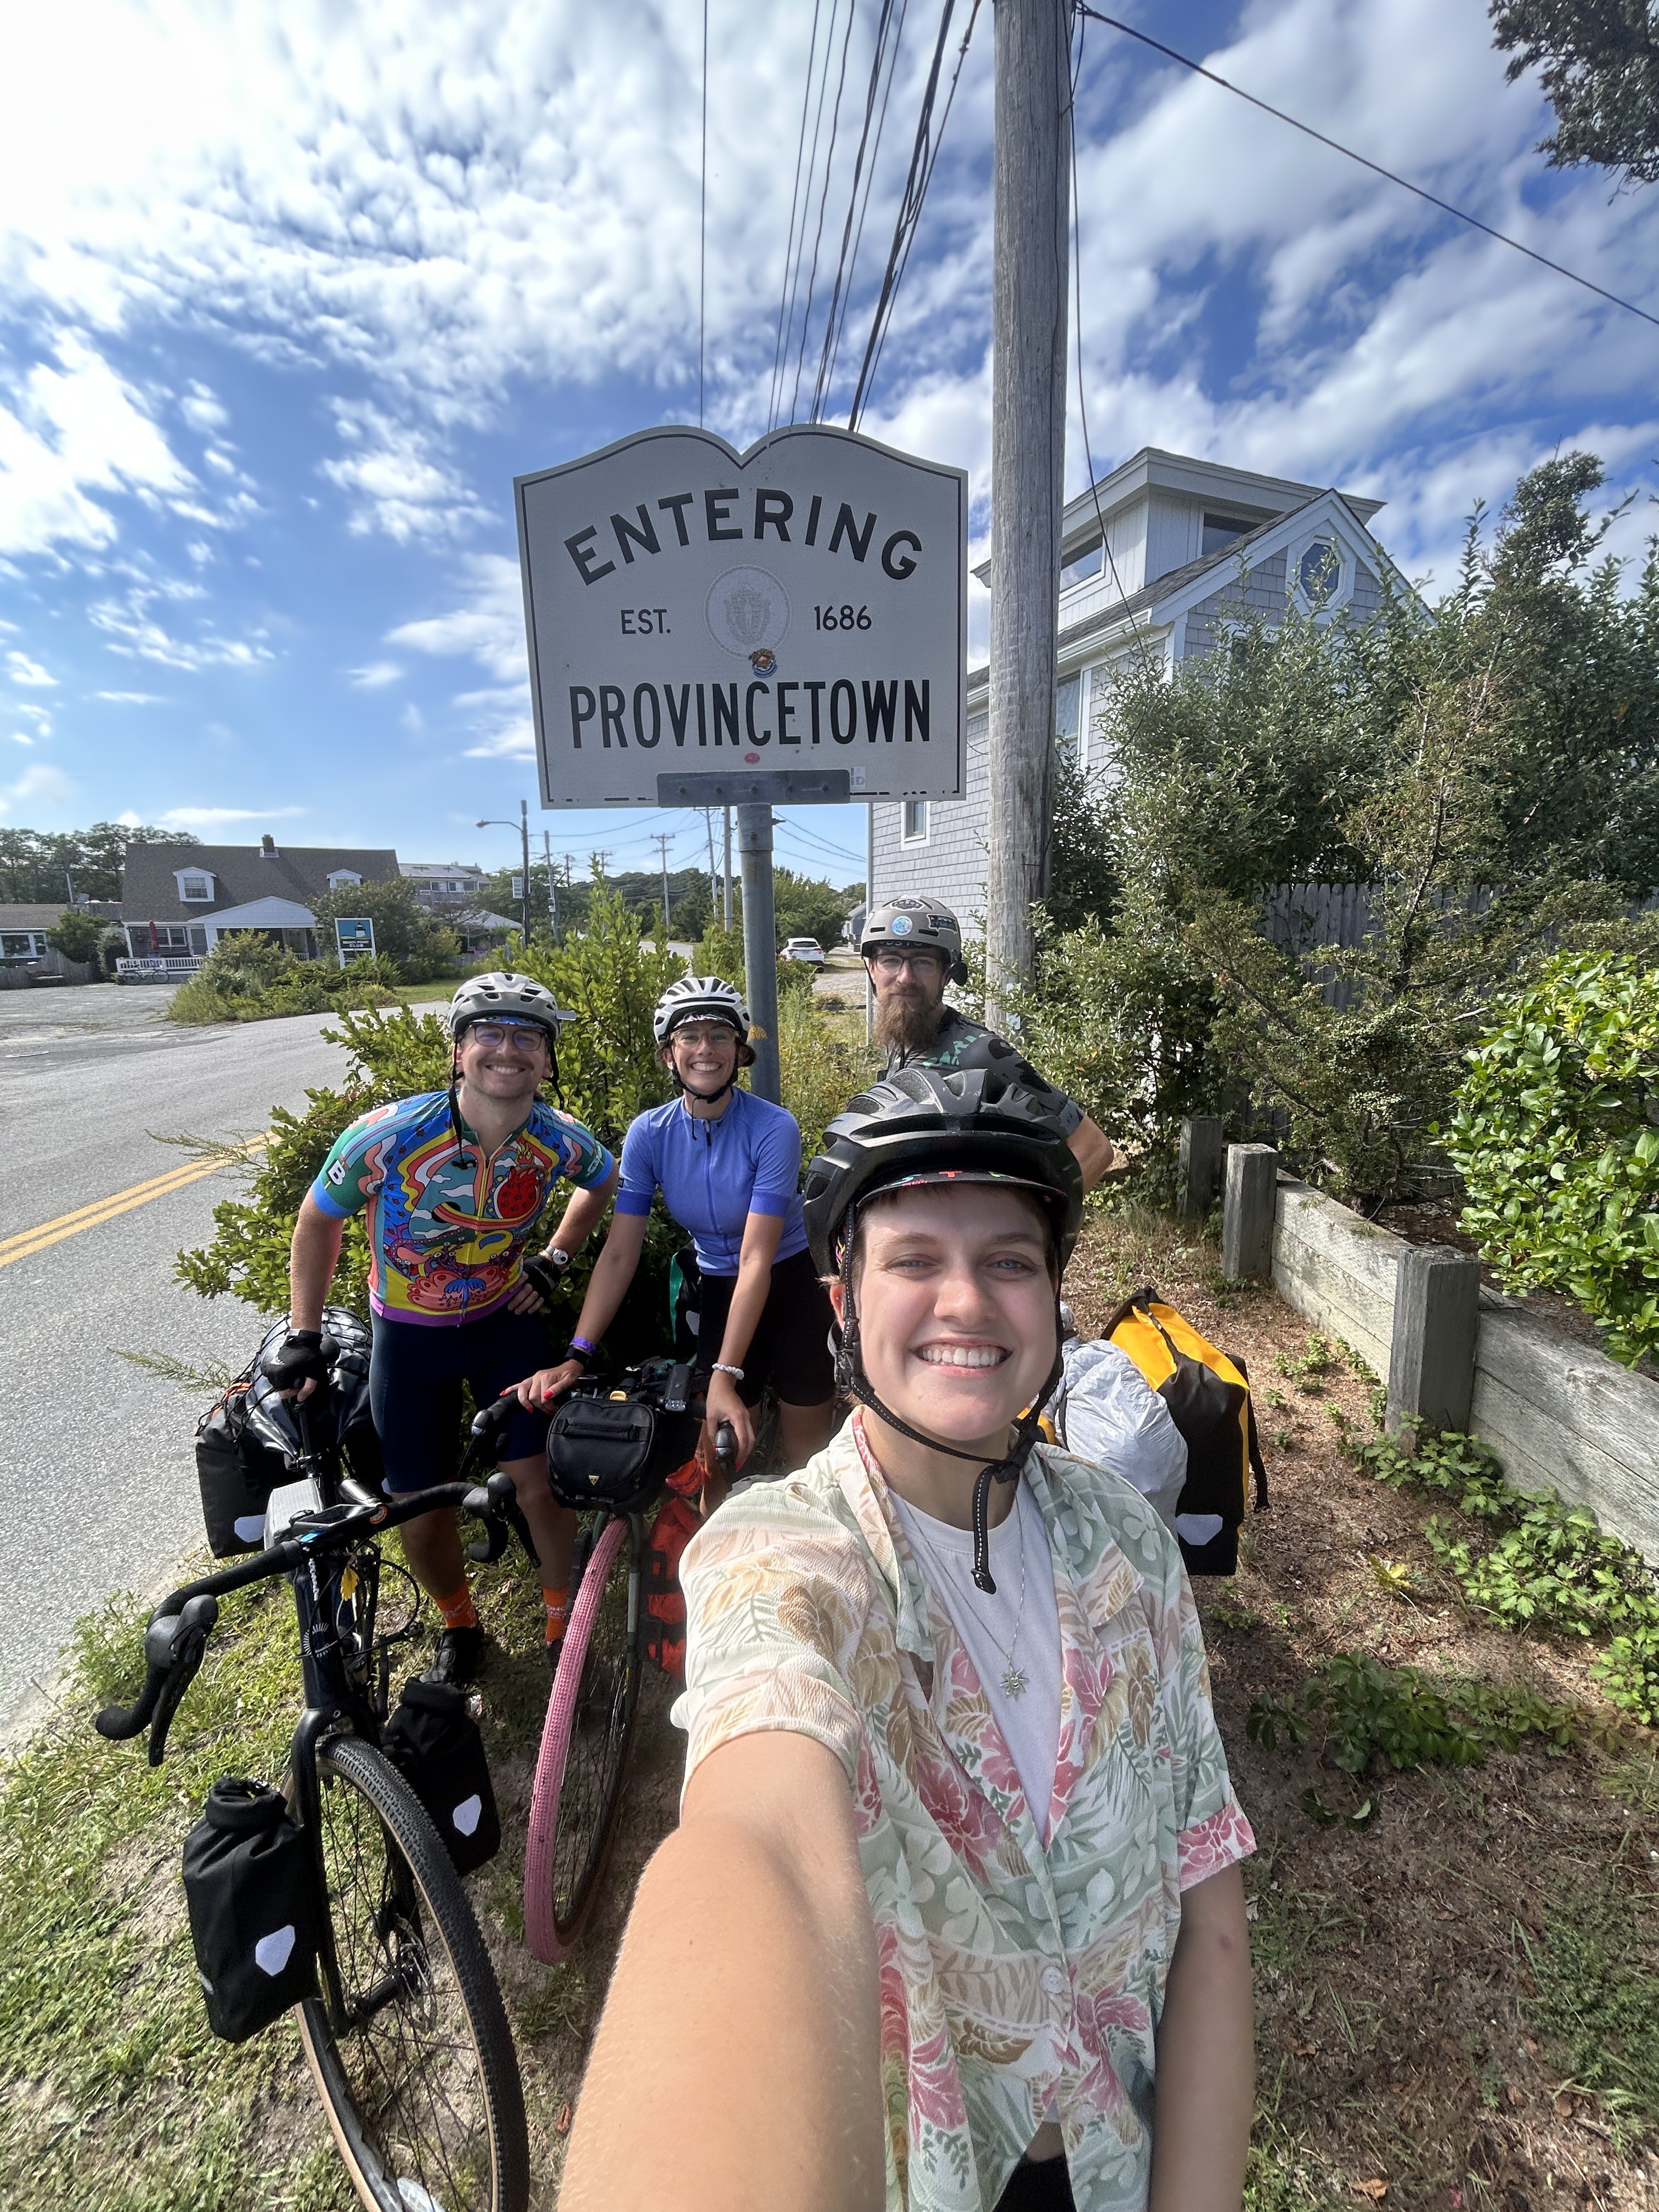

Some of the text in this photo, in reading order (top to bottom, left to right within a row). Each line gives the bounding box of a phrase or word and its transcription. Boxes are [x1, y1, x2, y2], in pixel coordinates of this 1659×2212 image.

[564, 488, 922, 585] ENTERING
[620, 605, 872, 634] EST. 1686
[569, 679, 930, 749] PROVINCETOWN
